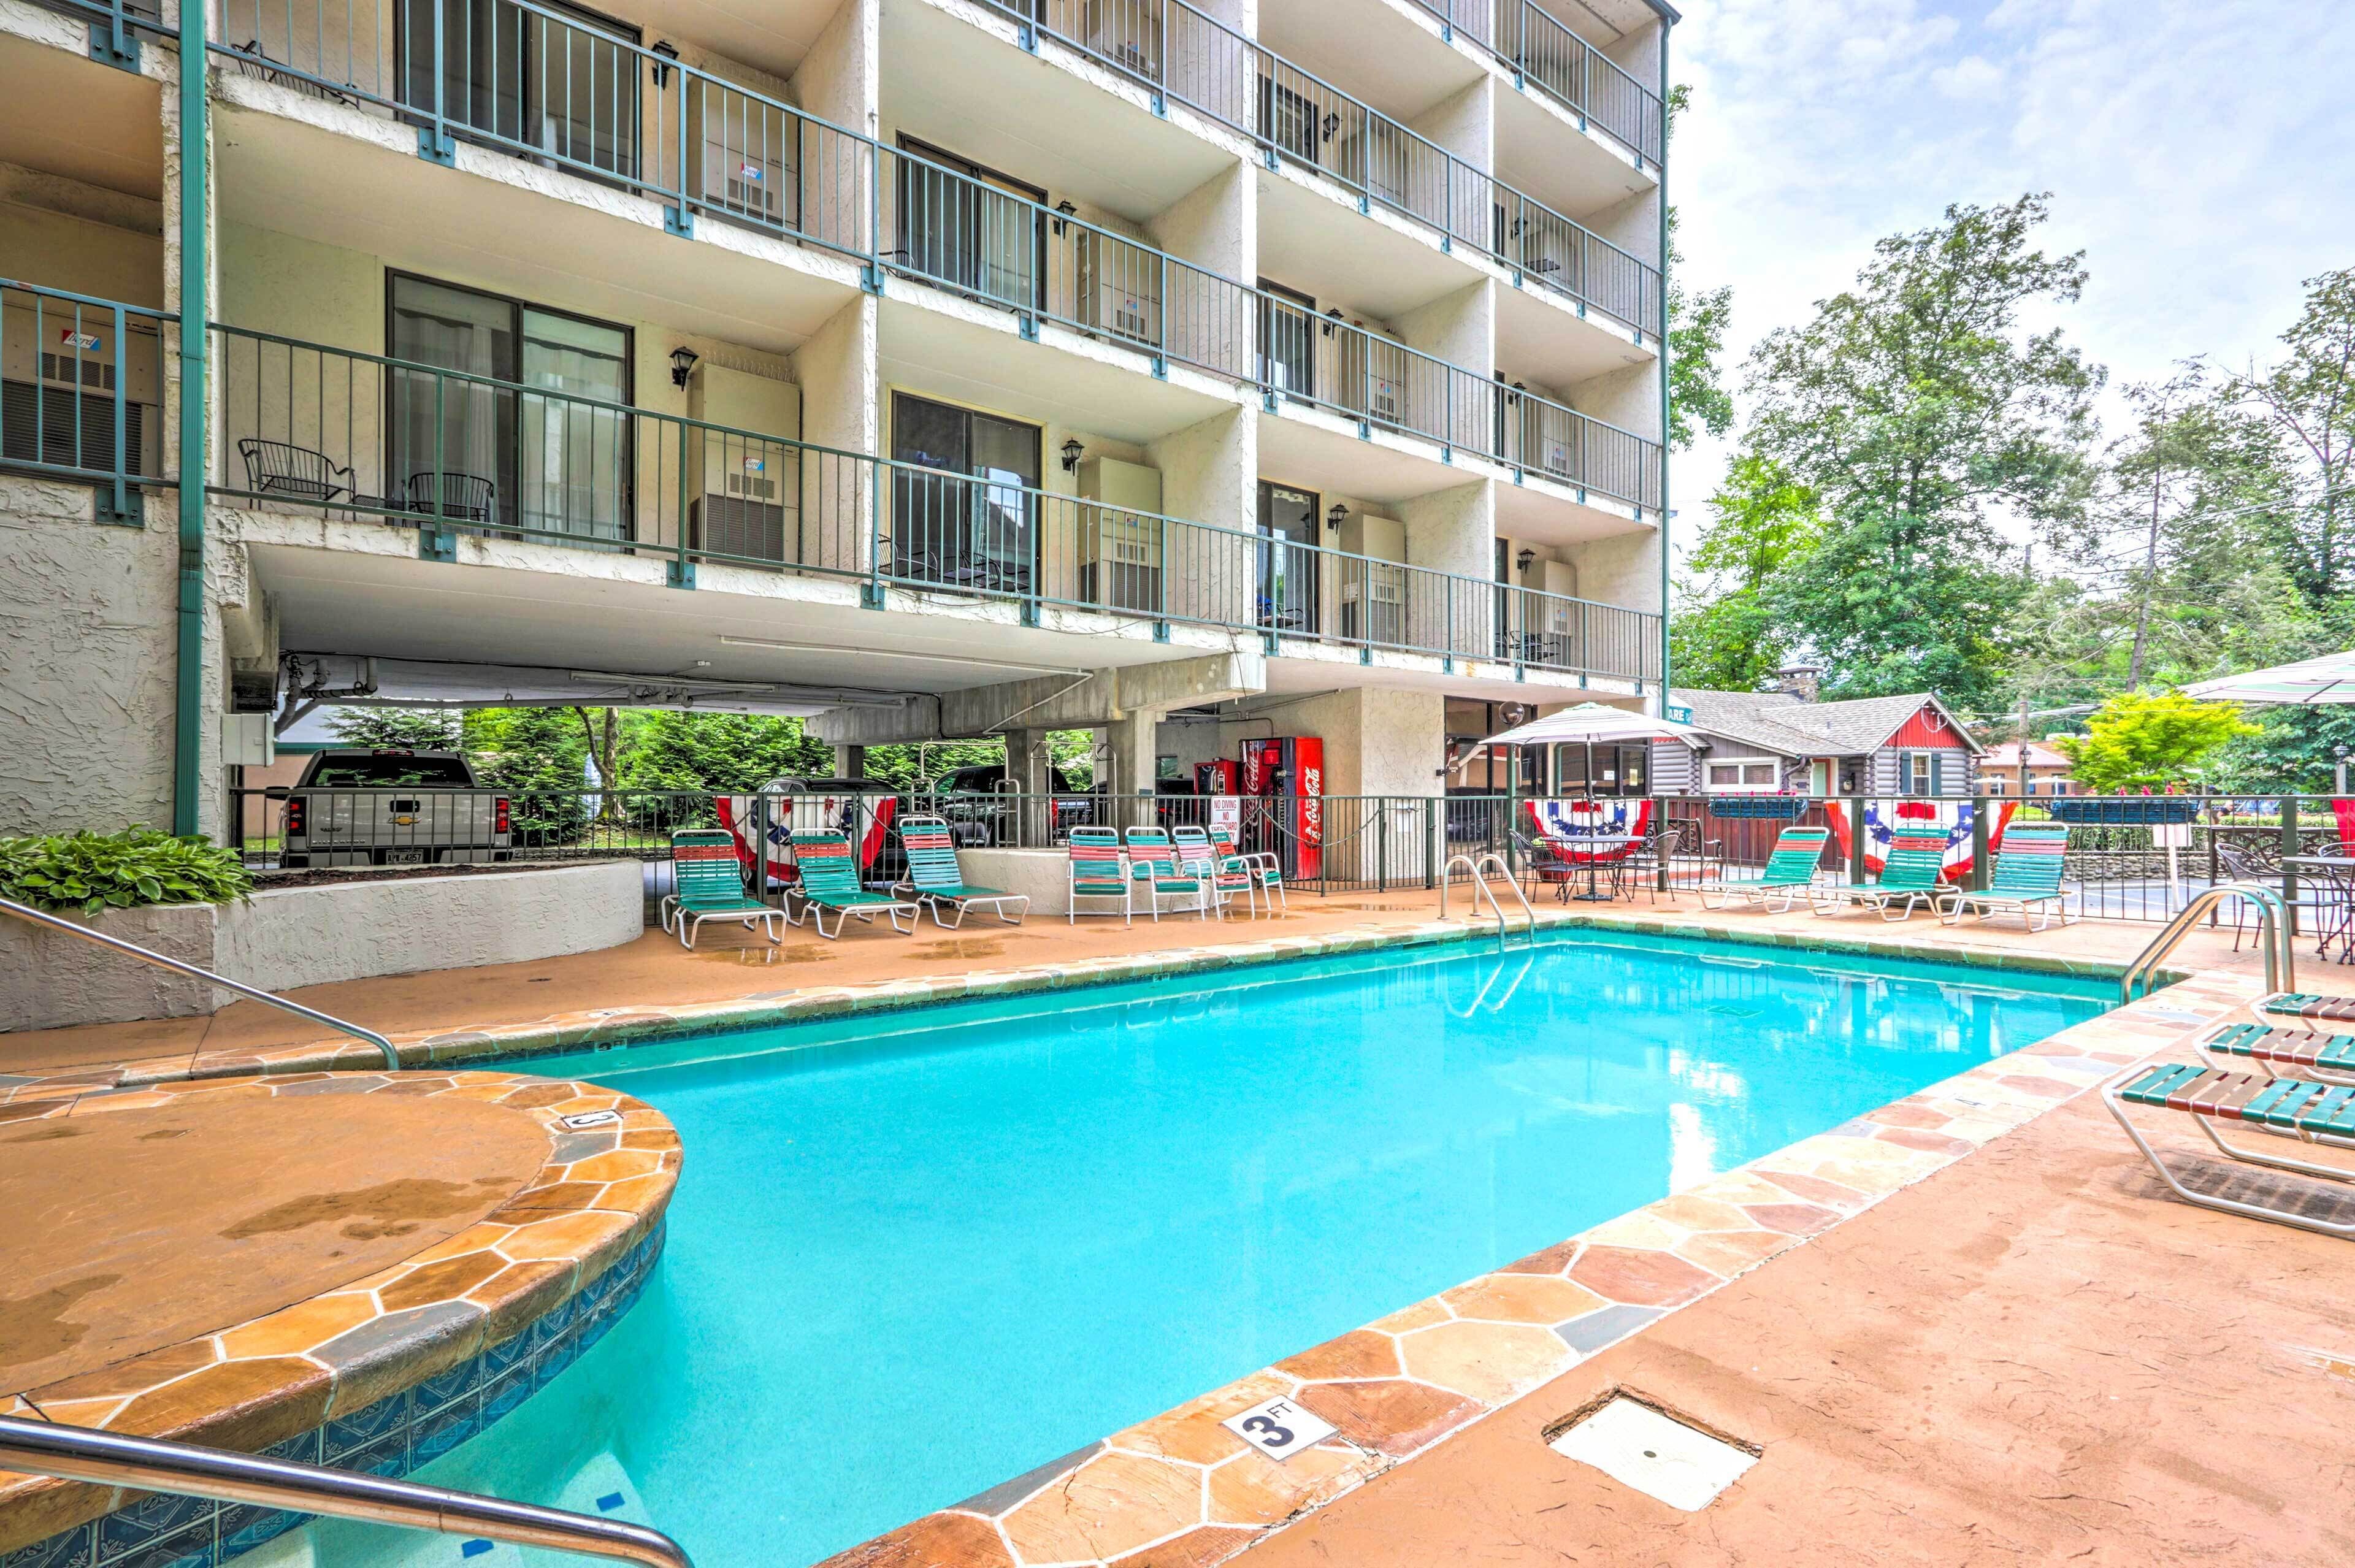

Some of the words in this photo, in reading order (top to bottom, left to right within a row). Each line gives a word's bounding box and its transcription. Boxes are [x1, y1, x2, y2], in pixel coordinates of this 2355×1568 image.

[1214, 800, 1220, 809] NO
[1222, 800, 1237, 809] DIVING
[1222, 811, 1229, 820] NO
[1266, 1402, 1293, 1418] FT
[1242, 1415, 1295, 1448] 3
